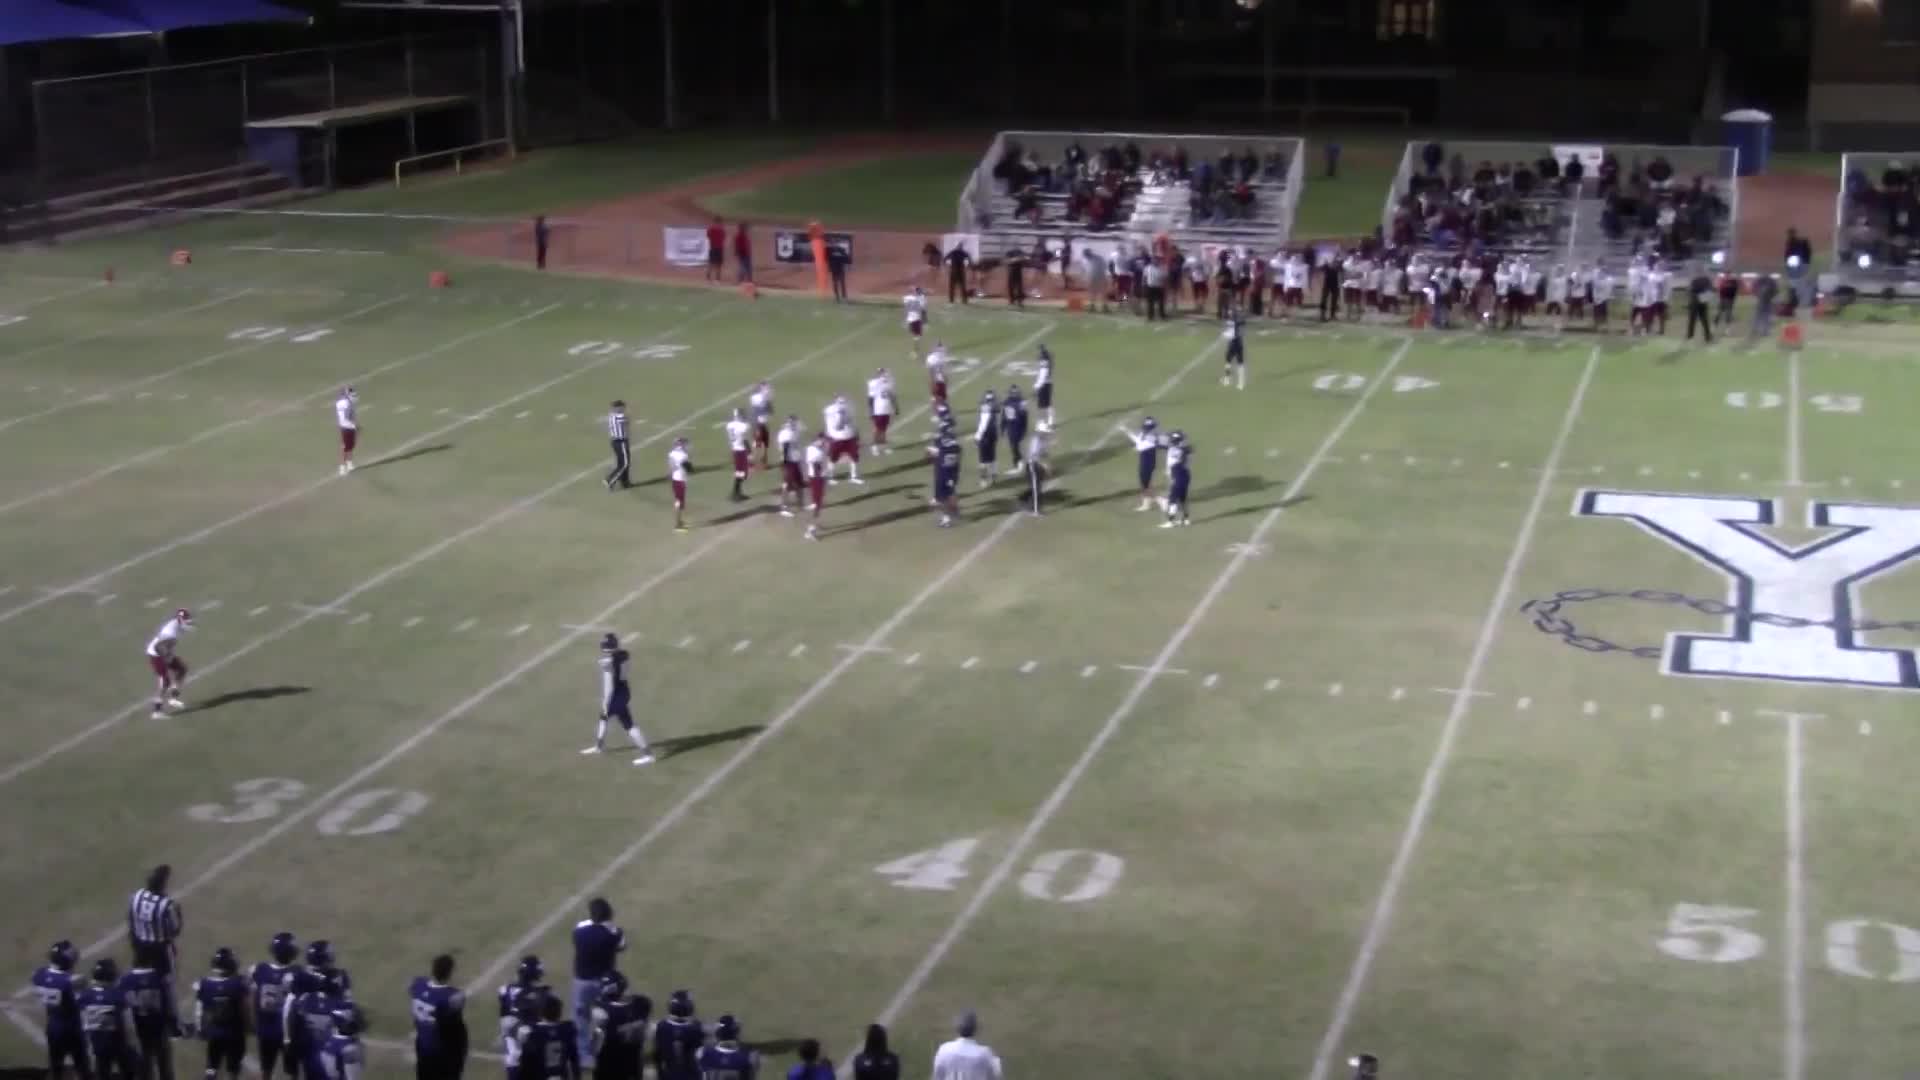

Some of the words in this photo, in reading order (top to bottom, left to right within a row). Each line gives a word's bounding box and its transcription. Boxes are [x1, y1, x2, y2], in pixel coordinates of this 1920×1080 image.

[1312, 373, 1442, 393] 40
[1724, 390, 1864, 413] 50
[1571, 488, 1920, 690] Y
[187, 777, 429, 836] 30
[874, 837, 1125, 902] 40
[1656, 902, 1920, 983] 50
